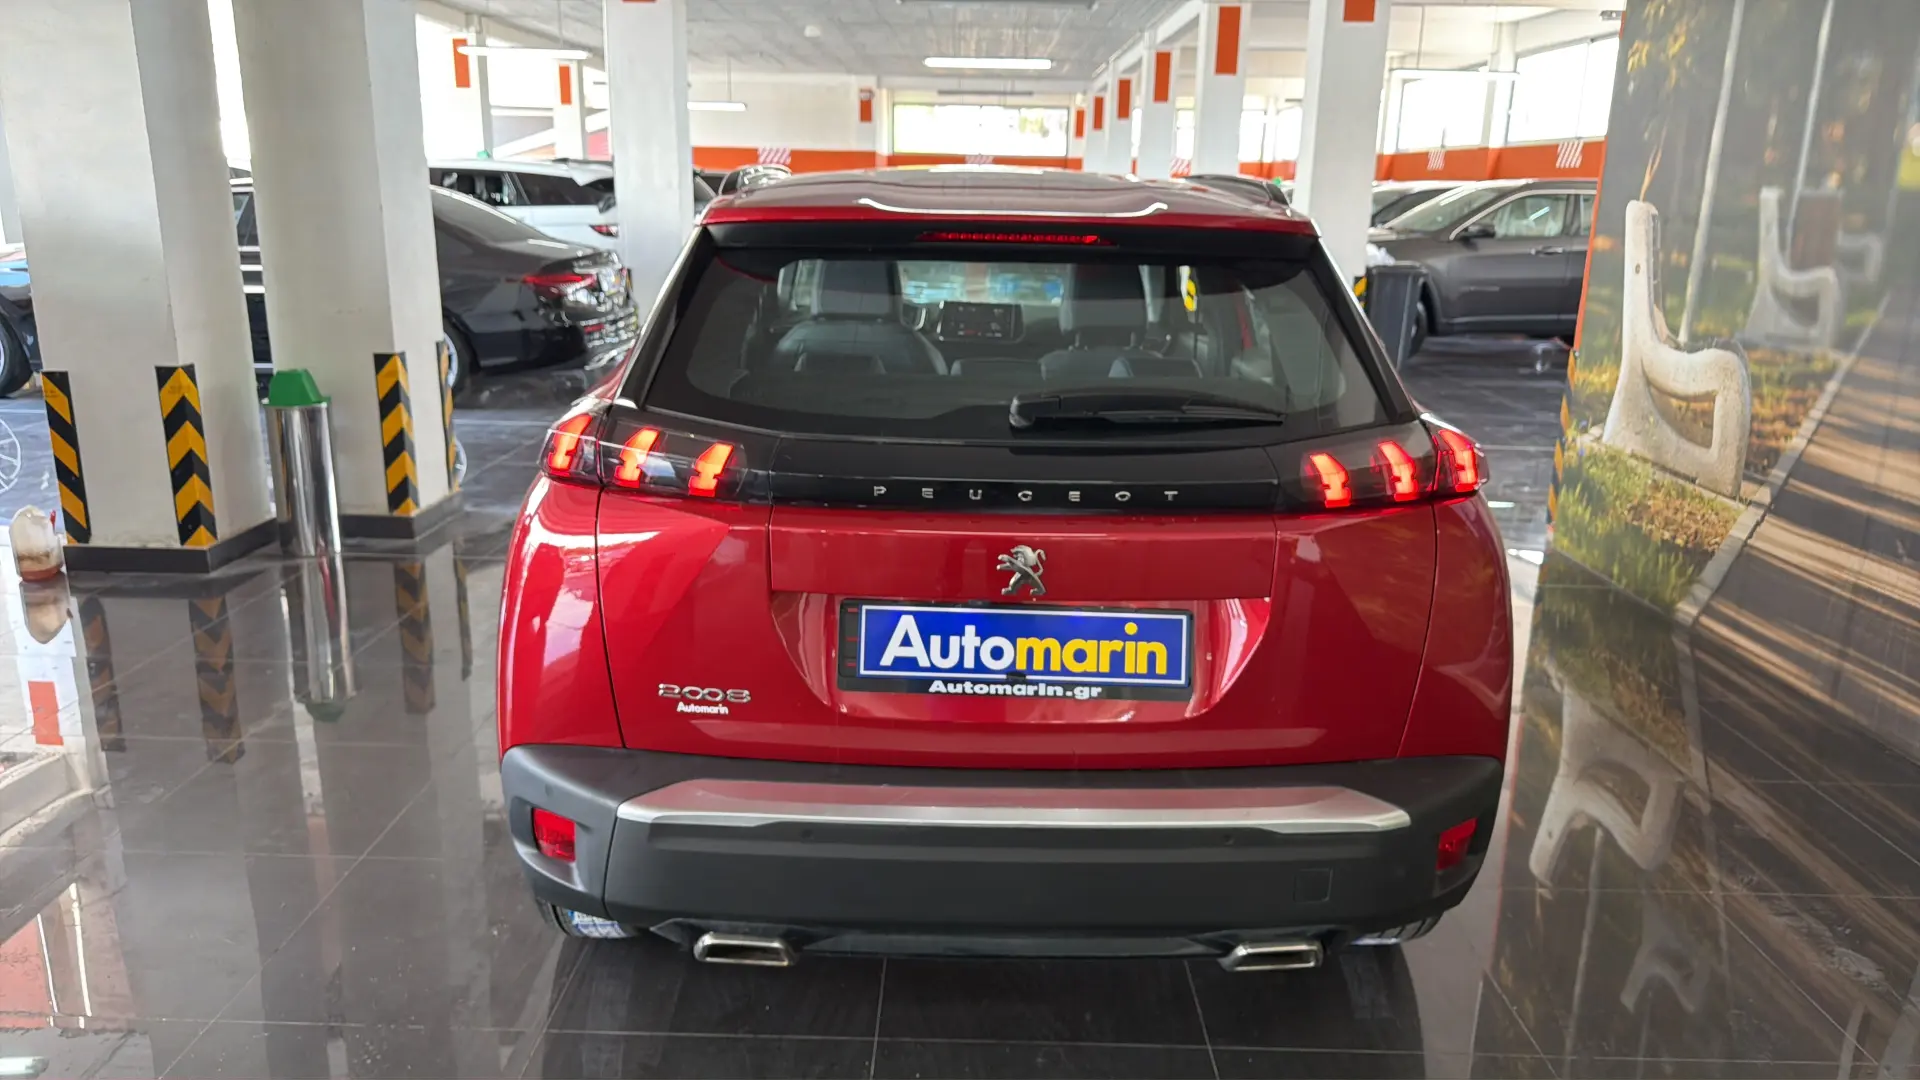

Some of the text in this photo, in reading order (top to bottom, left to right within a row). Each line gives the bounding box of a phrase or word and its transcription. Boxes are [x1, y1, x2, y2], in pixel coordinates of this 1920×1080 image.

[873, 486, 1179, 502] PEUGEOT
[879, 613, 1168, 675] Automarin
[658, 683, 752, 703] 2008
[676, 701, 729, 715] Automarin
